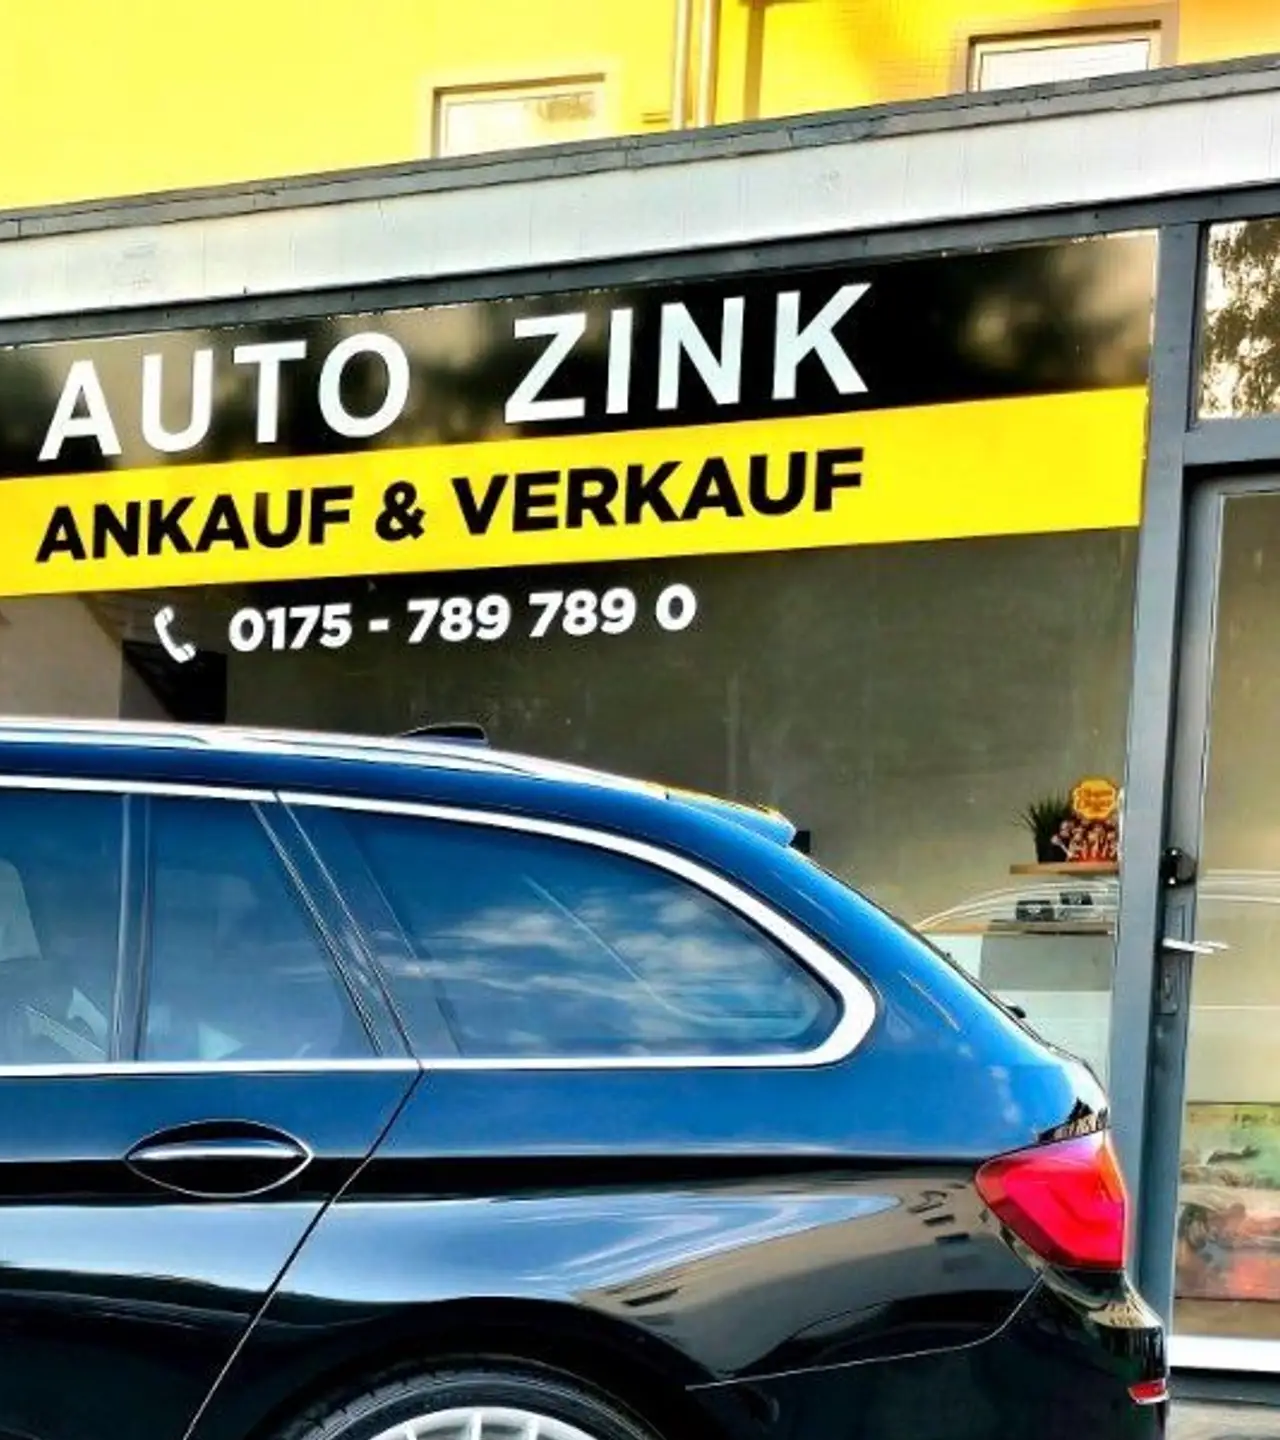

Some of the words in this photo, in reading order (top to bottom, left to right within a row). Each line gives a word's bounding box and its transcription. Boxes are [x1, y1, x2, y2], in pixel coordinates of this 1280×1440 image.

[38, 330, 411, 461] AUTO
[504, 282, 871, 424] ZINK
[35, 484, 354, 564] ANKAUF
[374, 480, 426, 542] &
[450, 446, 864, 536] VERKAUF
[227, 603, 353, 653] 0175
[368, 618, 390, 632] -
[406, 594, 511, 644] 789
[528, 586, 637, 637] 789
[654, 582, 698, 632] 0
